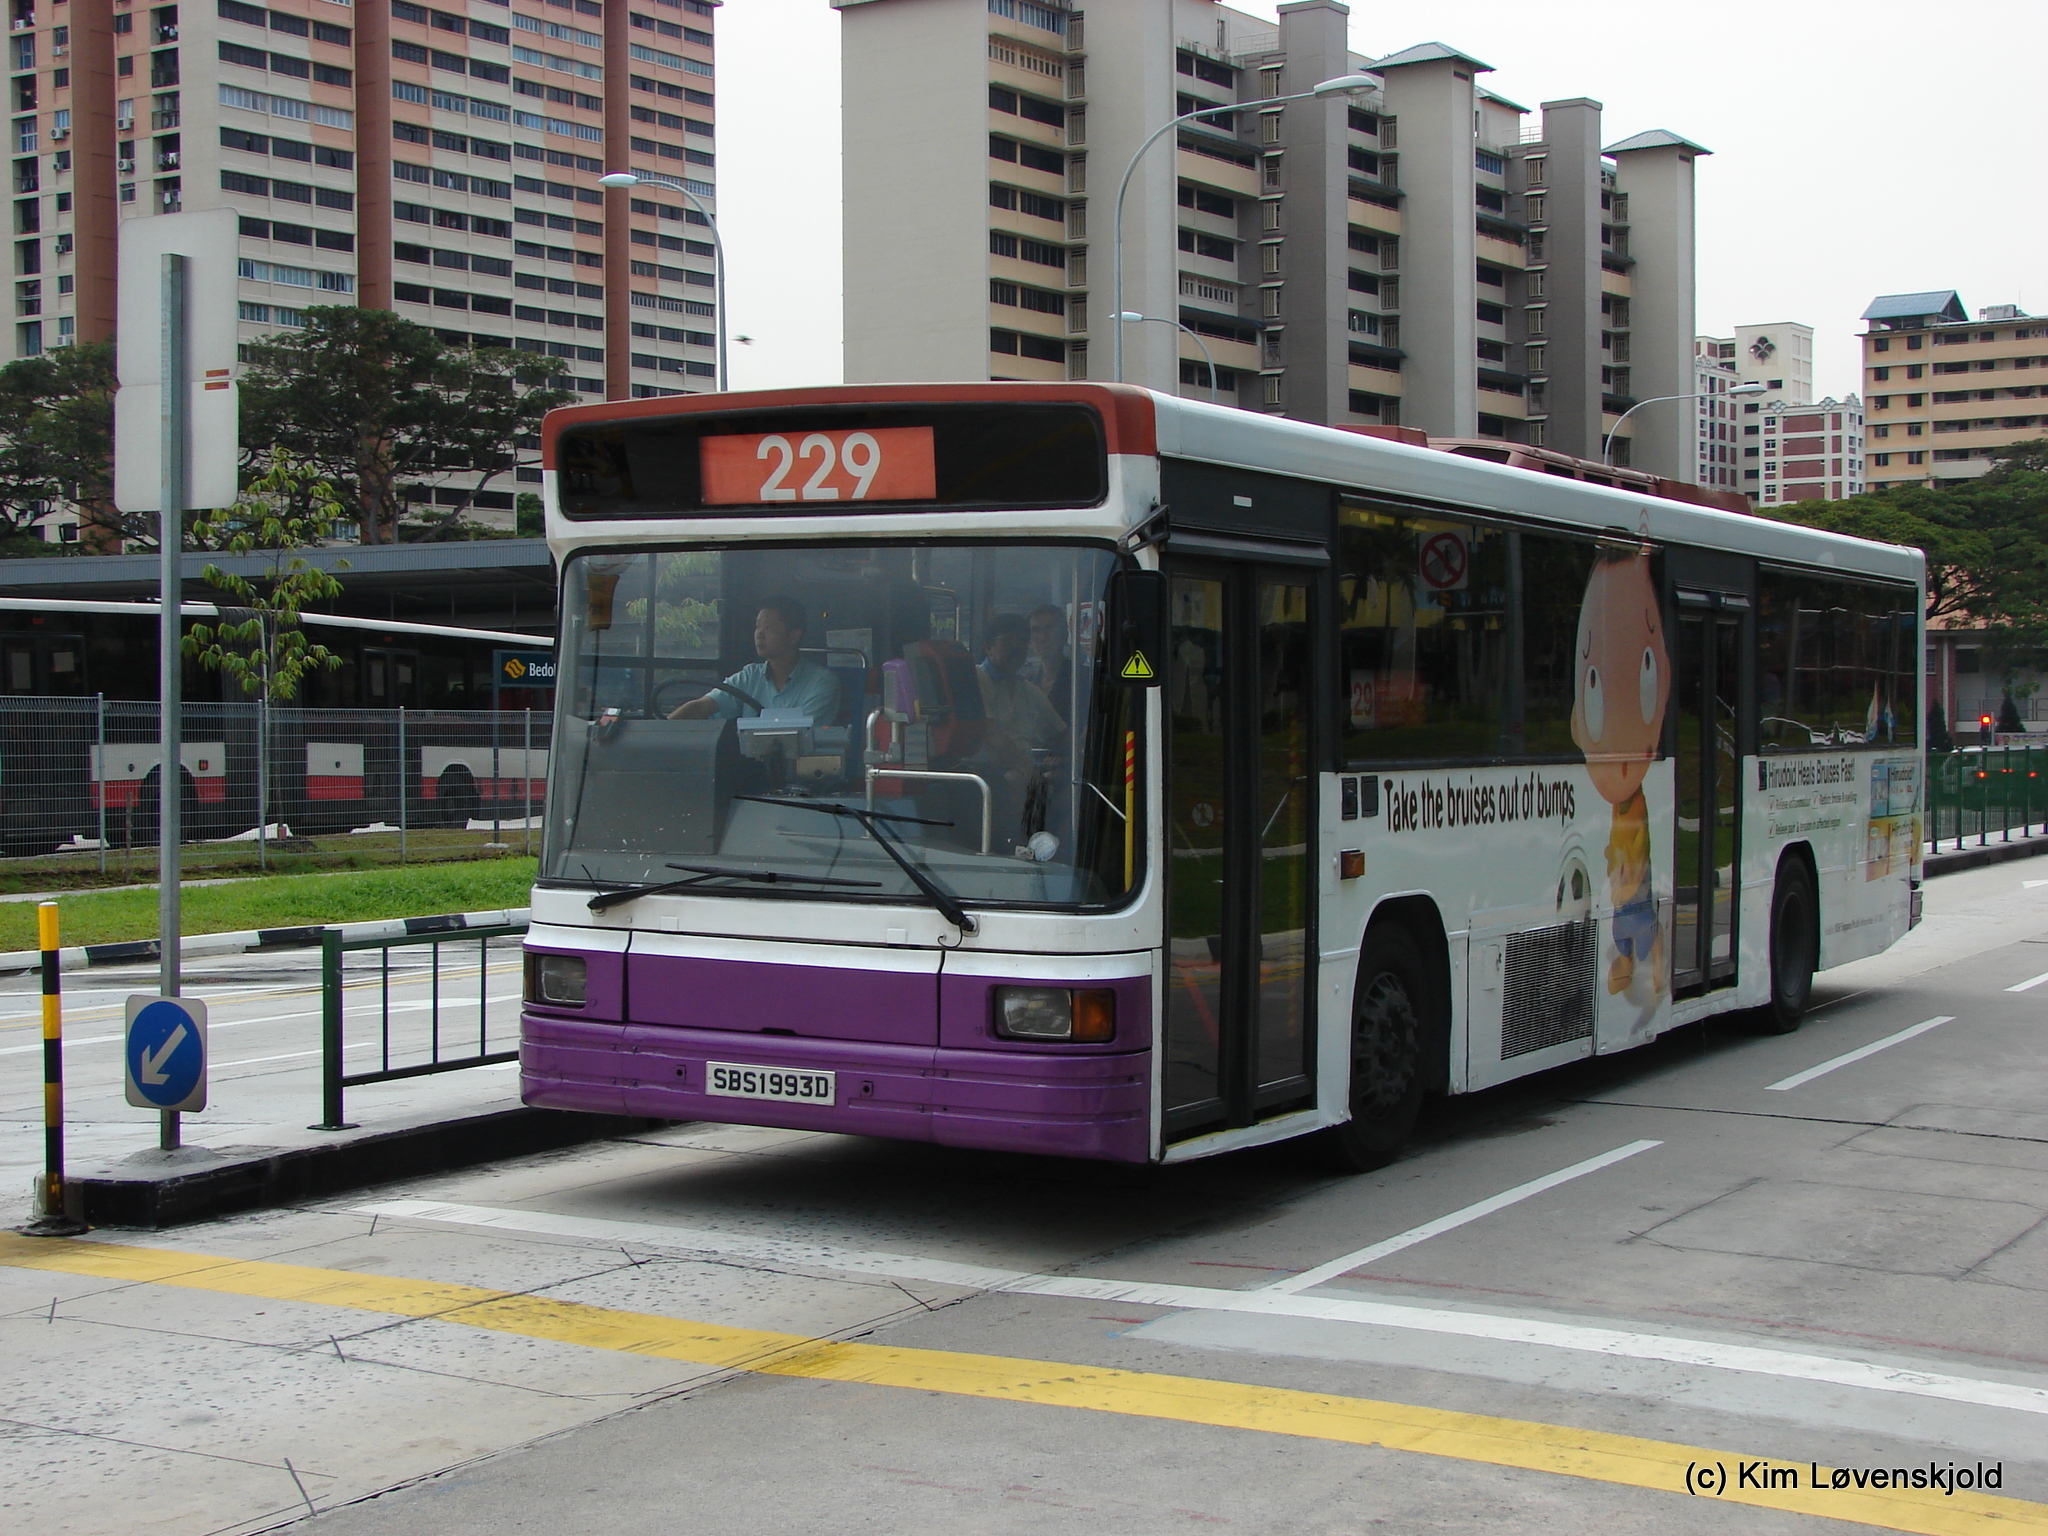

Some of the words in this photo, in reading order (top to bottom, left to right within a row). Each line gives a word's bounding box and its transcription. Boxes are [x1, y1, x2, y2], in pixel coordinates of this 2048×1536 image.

[756, 431, 881, 501] 229
[1768, 761, 1796, 788] Hirudoid
[1798, 760, 1815, 786] Heals
[1816, 759, 1840, 784] Bruises
[1841, 757, 1856, 782] Fast!
[1384, 779, 1417, 833] Take
[1421, 777, 1443, 829] the
[1447, 774, 1495, 828] bruises
[1499, 775, 1518, 823] out
[1522, 771, 1534, 820] of
[1537, 772, 1575, 828] bumps
[714, 1068, 829, 1098] SBS1993D
